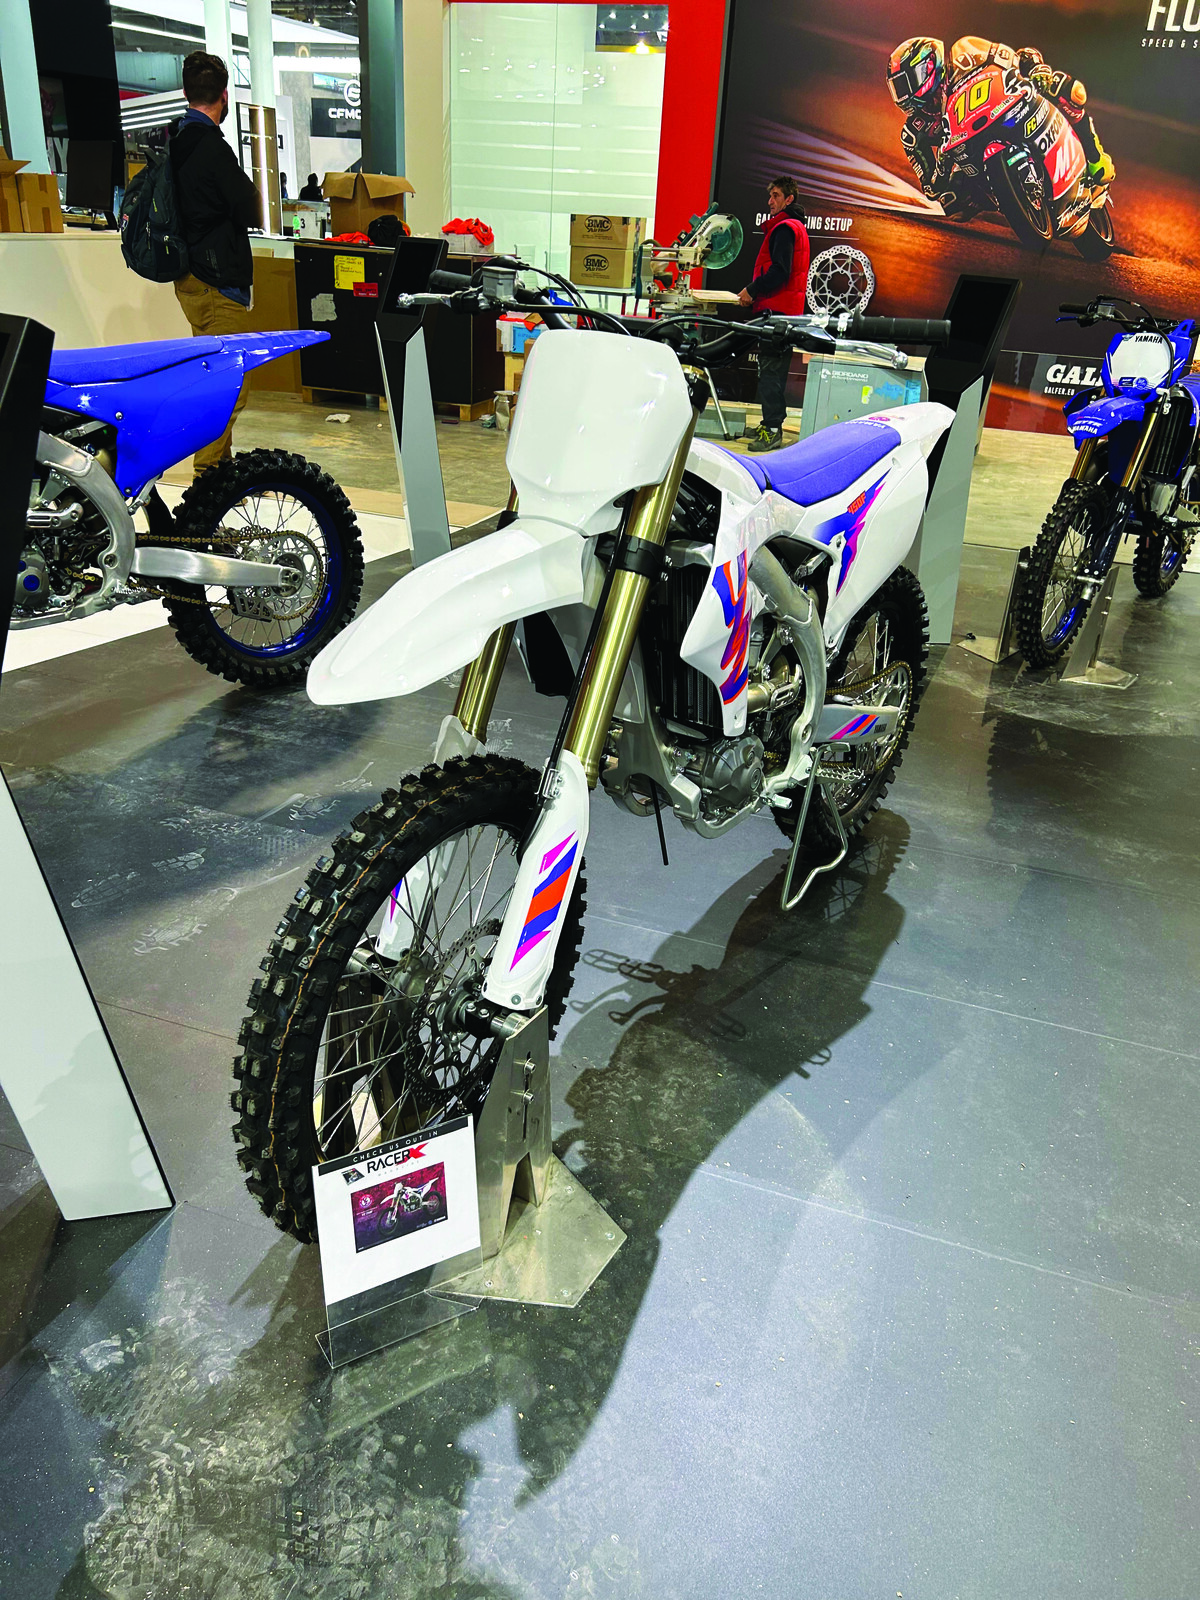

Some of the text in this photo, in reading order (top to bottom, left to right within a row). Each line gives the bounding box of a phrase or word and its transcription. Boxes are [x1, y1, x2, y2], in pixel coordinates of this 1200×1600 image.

[1141, 38, 1174, 48] SPEED
[1180, 39, 1186, 48] &
[953, 77, 994, 126] 10
[1026, 116, 1038, 136] FC
[300, 218, 306, 229] 3
[587, 218, 609, 230] BMC
[824, 216, 853, 232] SETUP
[585, 258, 607, 269] BMC
[1134, 335, 1163, 344] YAMAHA
[1045, 363, 1104, 387] GAL
[1044, 386, 1075, 396] GALFER.EU
[352, 1148, 383, 1163] CHECK
[389, 1143, 399, 1151] US
[405, 1135, 423, 1145] OUT
